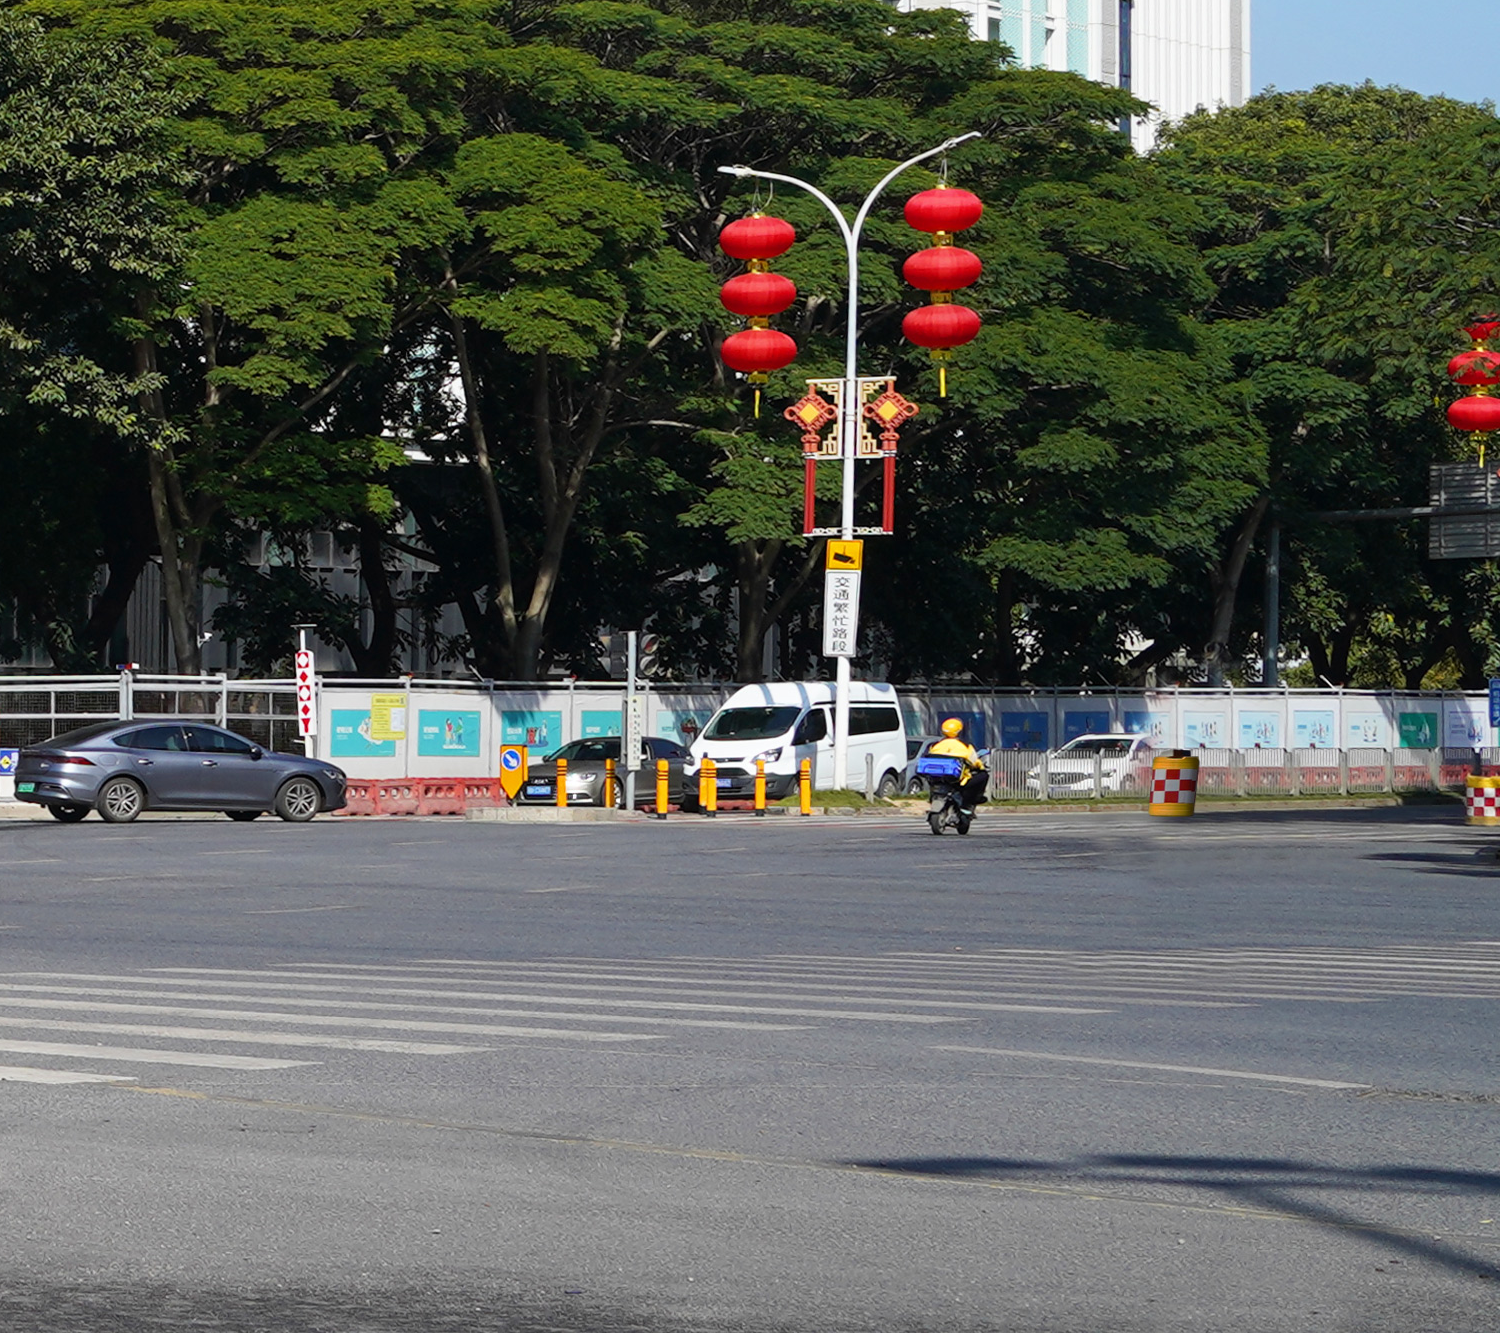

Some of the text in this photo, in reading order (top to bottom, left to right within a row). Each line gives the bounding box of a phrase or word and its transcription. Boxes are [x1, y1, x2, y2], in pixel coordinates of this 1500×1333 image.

[831, 576, 851, 653] 交通繁忙路段
